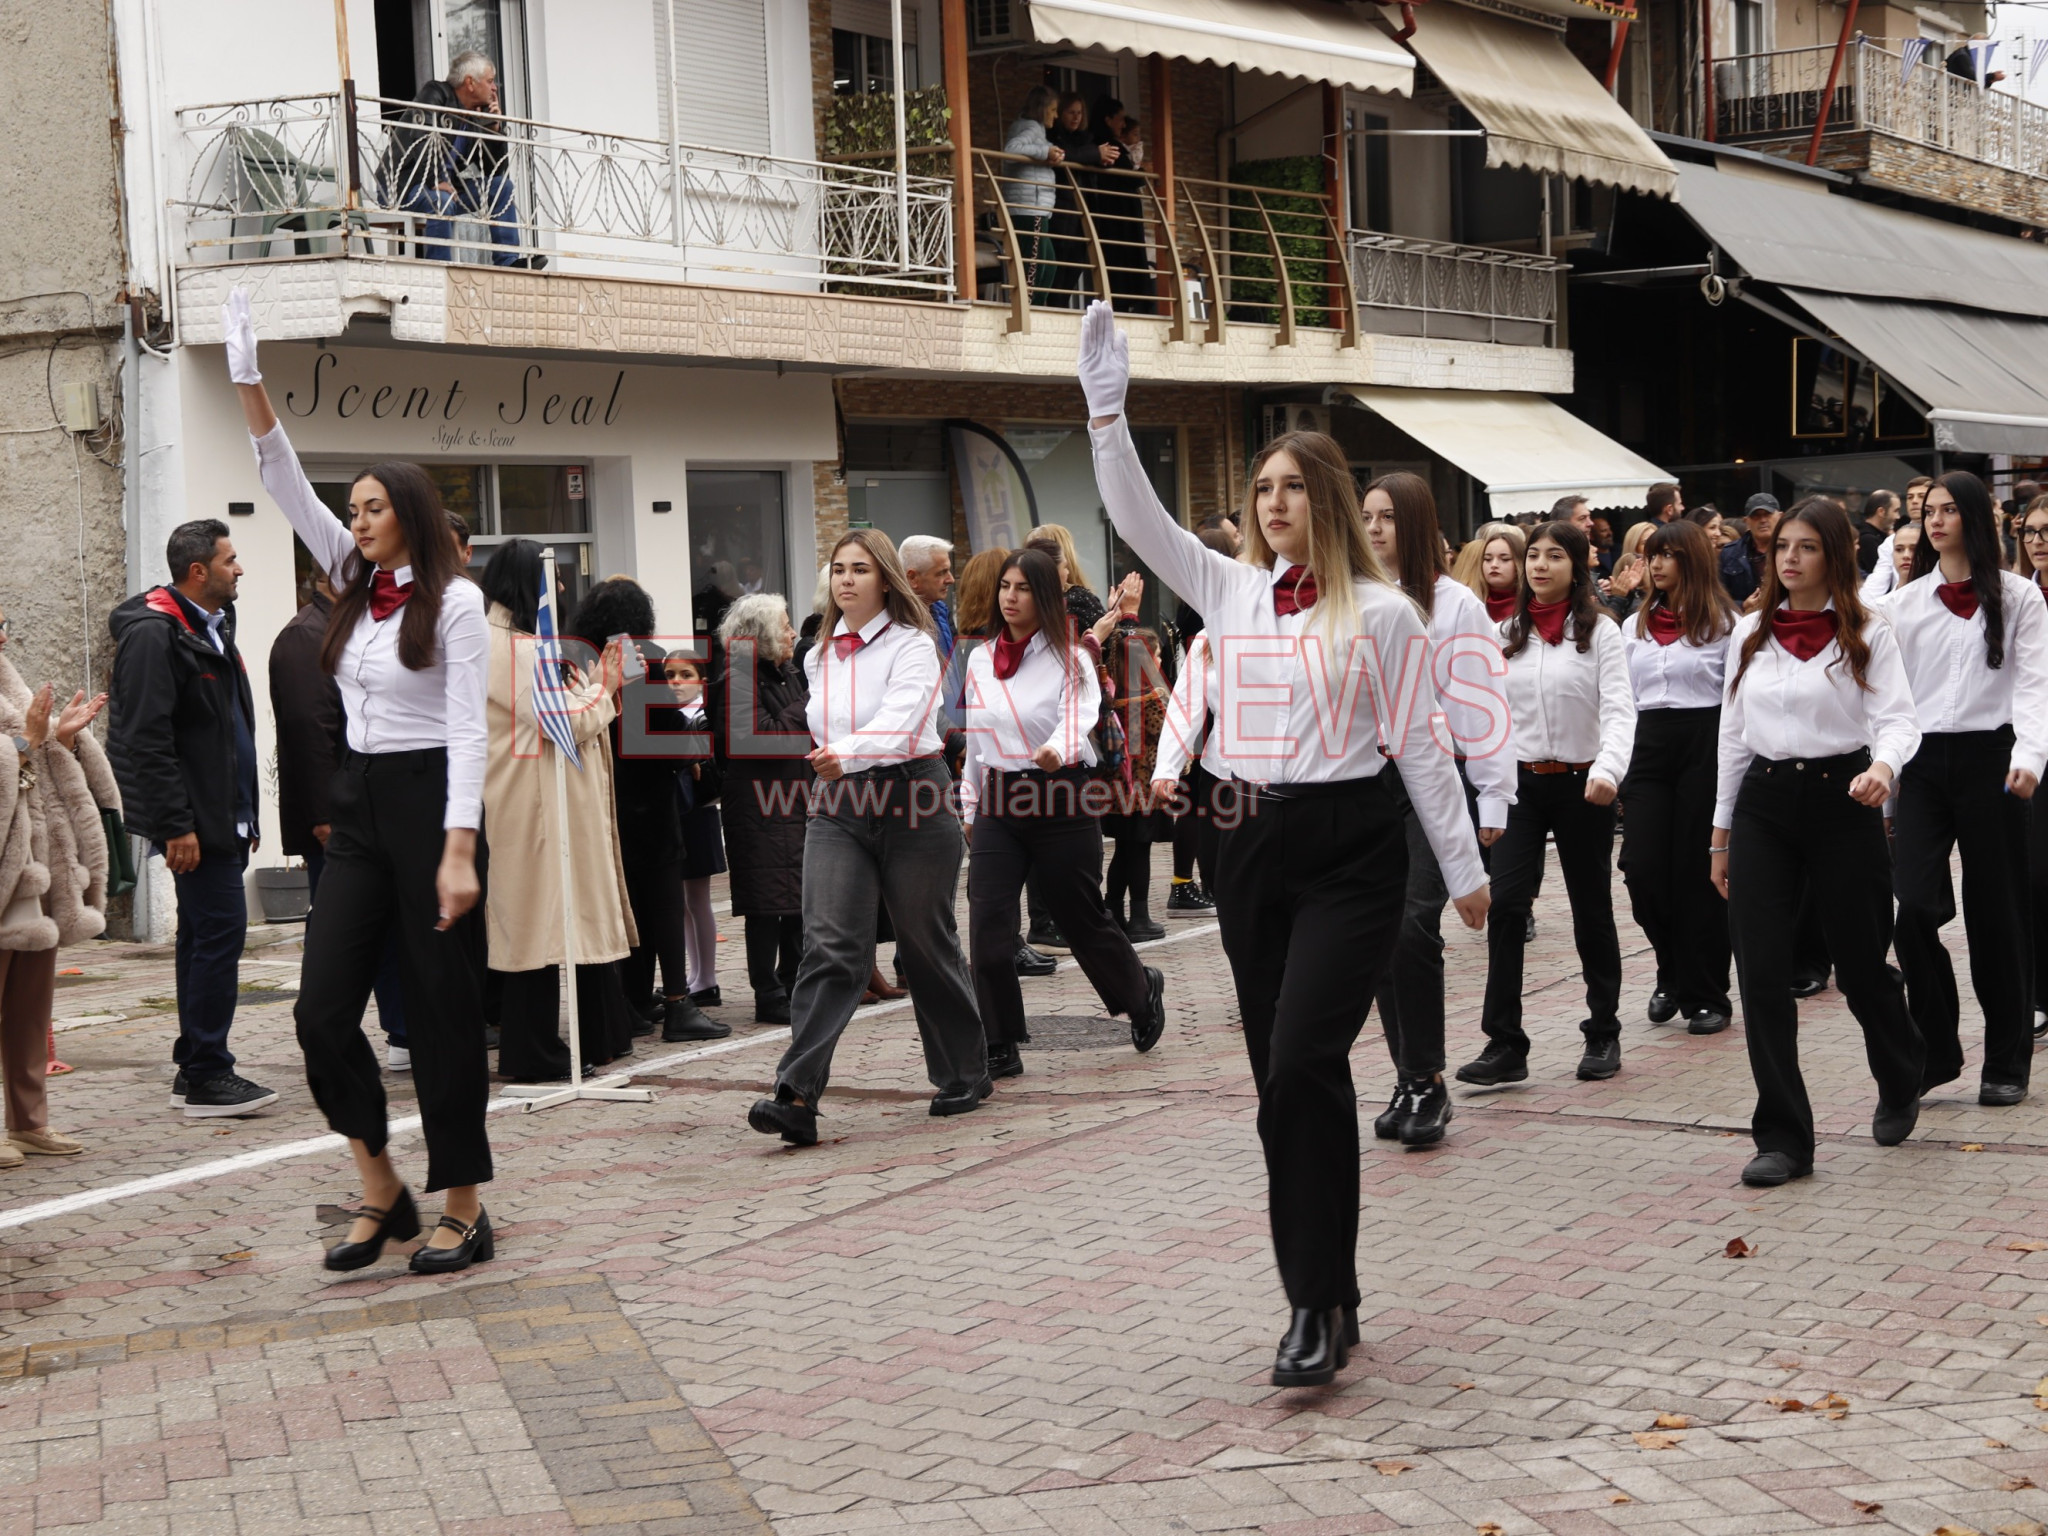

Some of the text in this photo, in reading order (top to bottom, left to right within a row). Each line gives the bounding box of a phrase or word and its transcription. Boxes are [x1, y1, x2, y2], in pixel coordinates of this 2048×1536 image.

[286, 352, 624, 426] Scent Seal
[432, 424, 515, 451] Style & Scent
